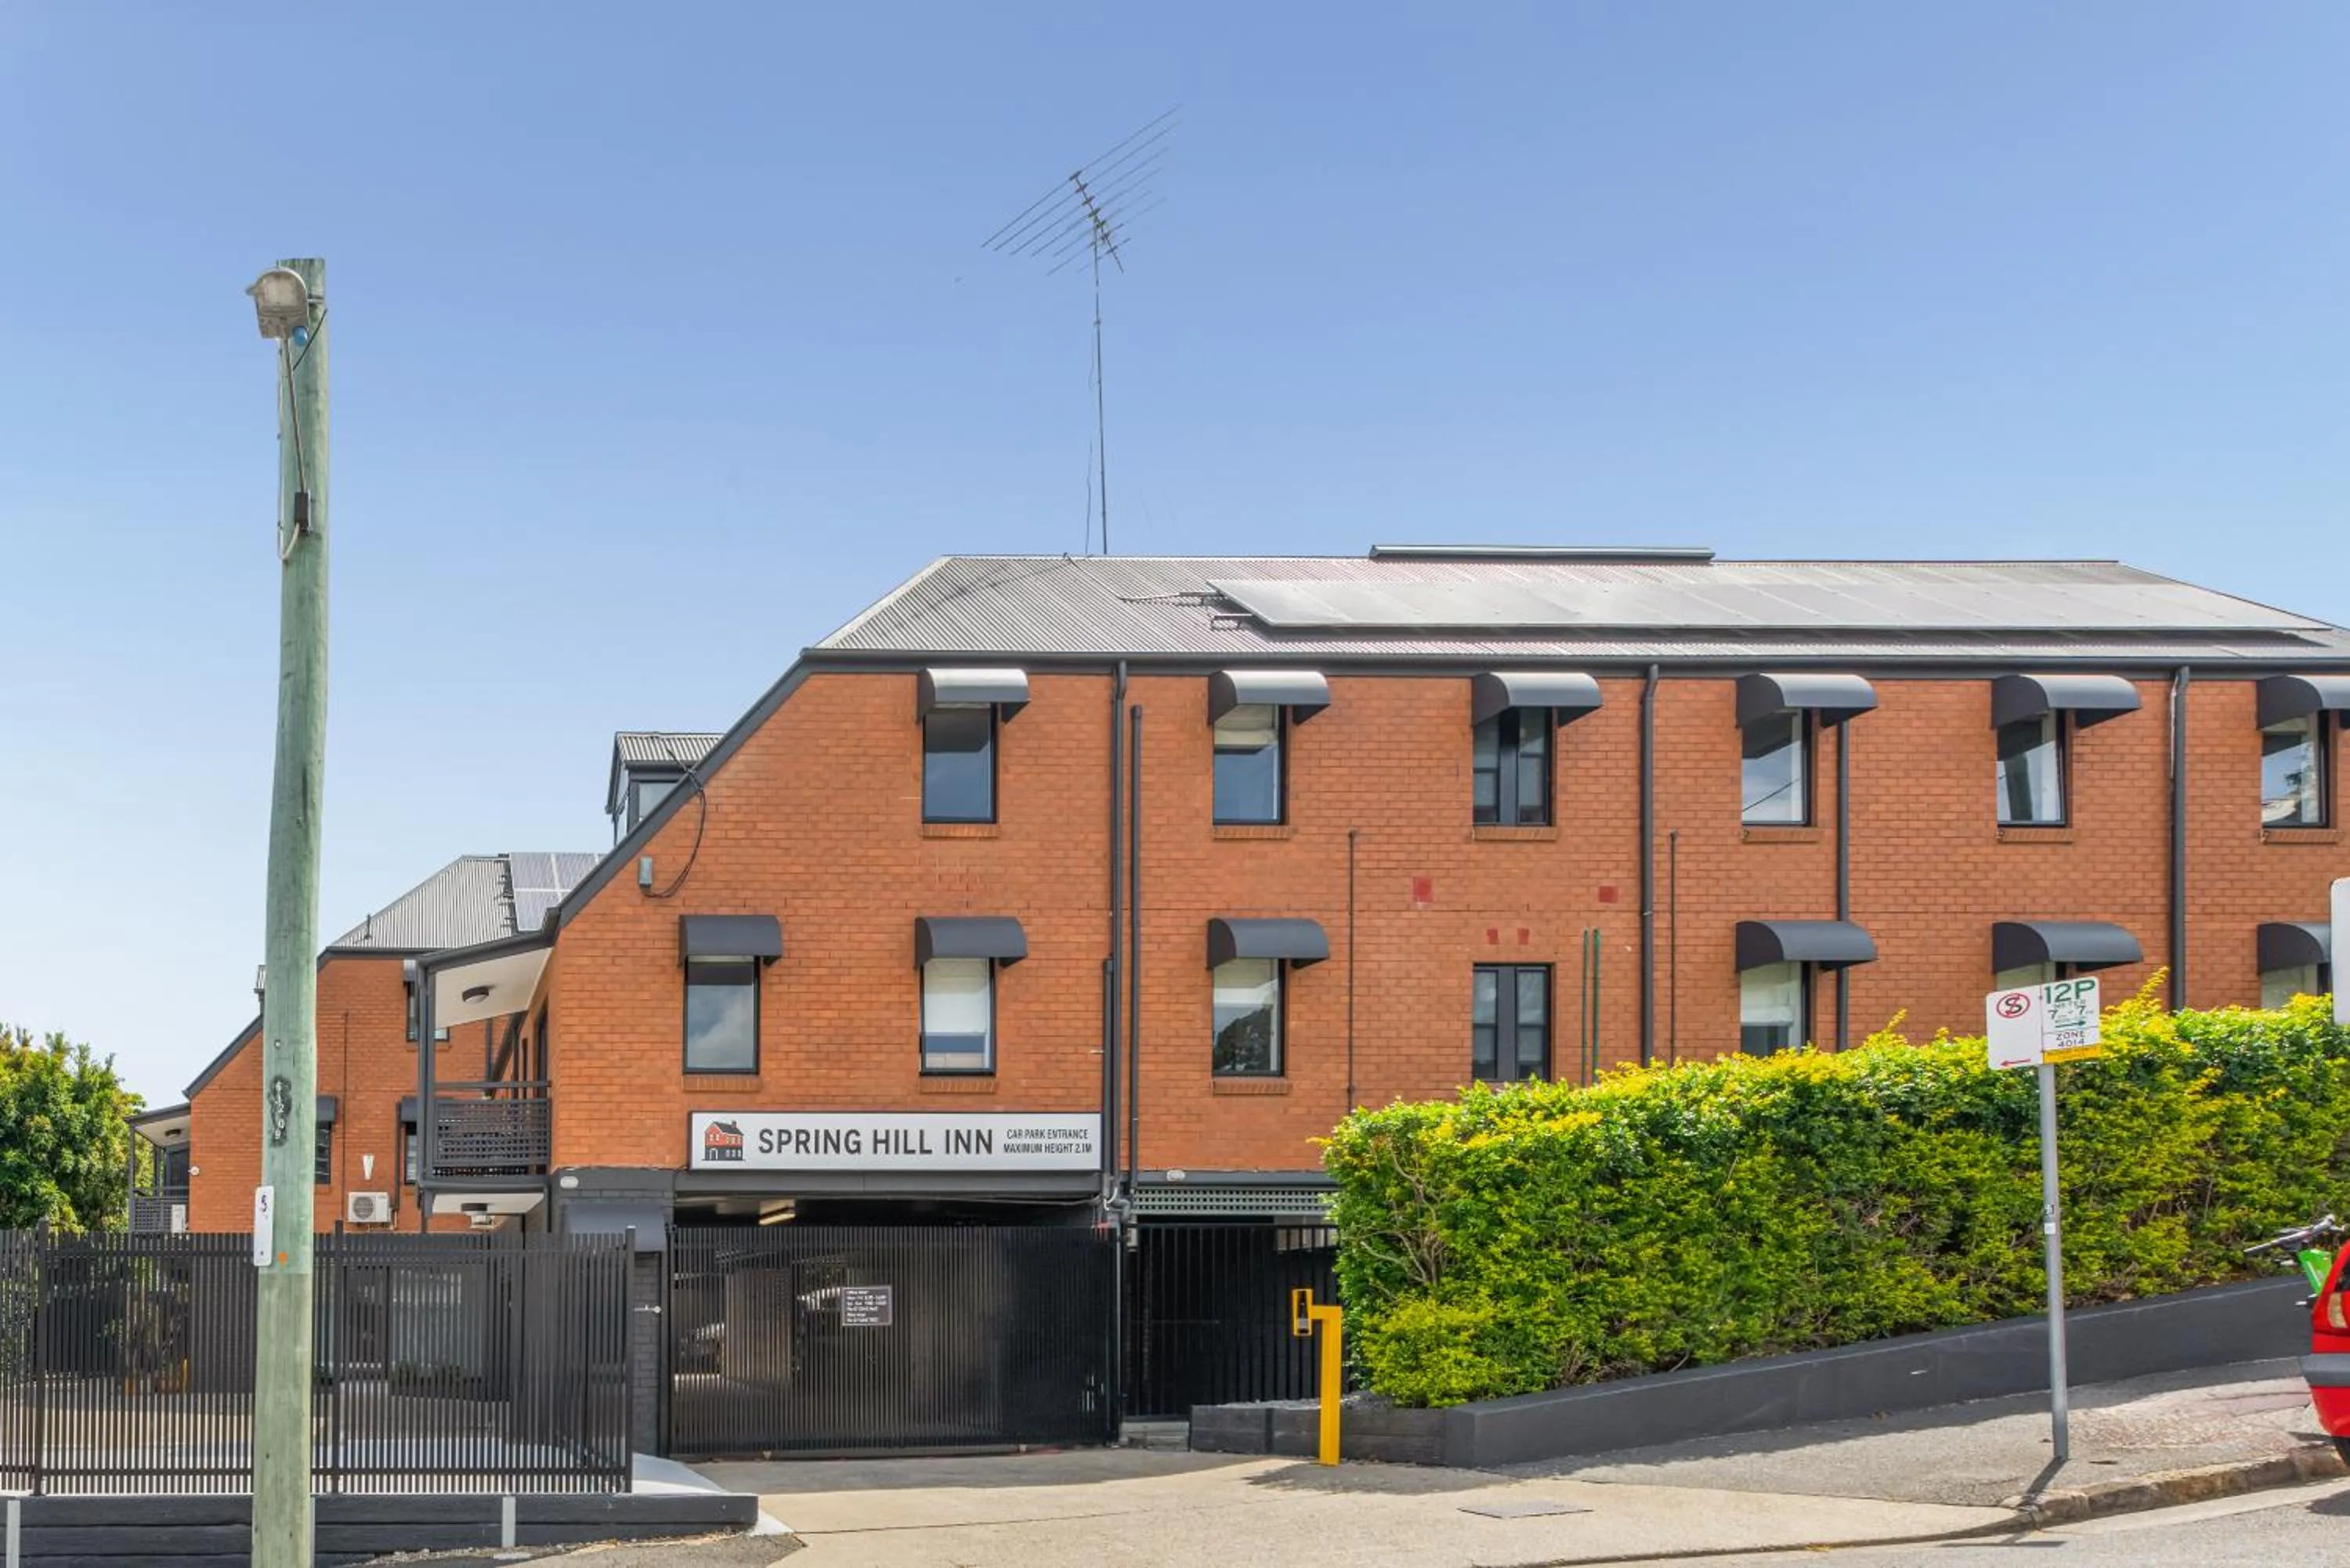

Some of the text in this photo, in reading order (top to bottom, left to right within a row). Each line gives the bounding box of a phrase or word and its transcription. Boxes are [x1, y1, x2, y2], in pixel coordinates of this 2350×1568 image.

[2044, 980, 2095, 1004] 12P
[2048, 1010, 2058, 1020] 7
[2077, 1005, 2087, 1015] 7
[2056, 1030, 2086, 1041] ZONE
[1007, 1129, 1088, 1139] CAR PARK ENTRANCE
[757, 1128, 993, 1154] SPRING HILL INN
[1003, 1143, 1043, 1153] MAXIMUM
[1044, 1143, 1073, 1153] HEIGHT
